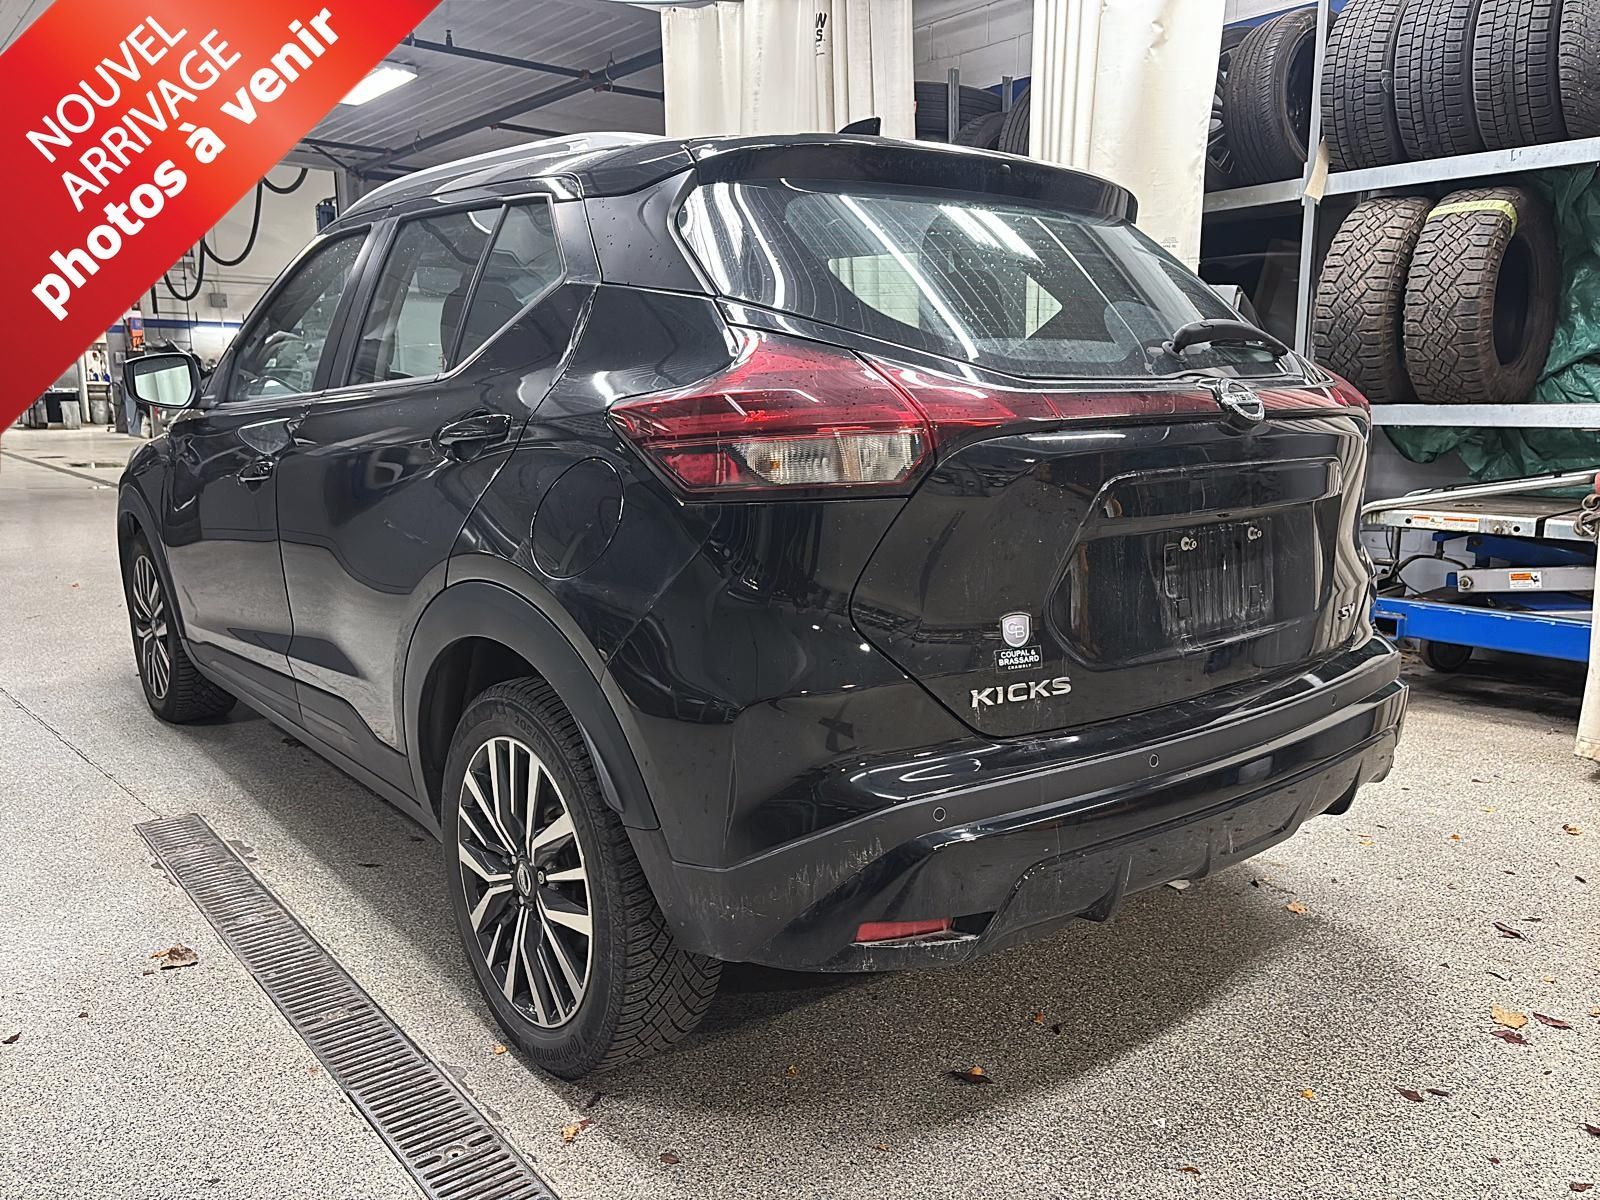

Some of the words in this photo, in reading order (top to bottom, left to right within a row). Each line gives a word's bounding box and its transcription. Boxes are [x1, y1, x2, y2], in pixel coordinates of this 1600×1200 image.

[1001, 649, 1030, 659] COUPAL
[998, 655, 1039, 666] BRASSARD
[970, 677, 1072, 707] KICKS
